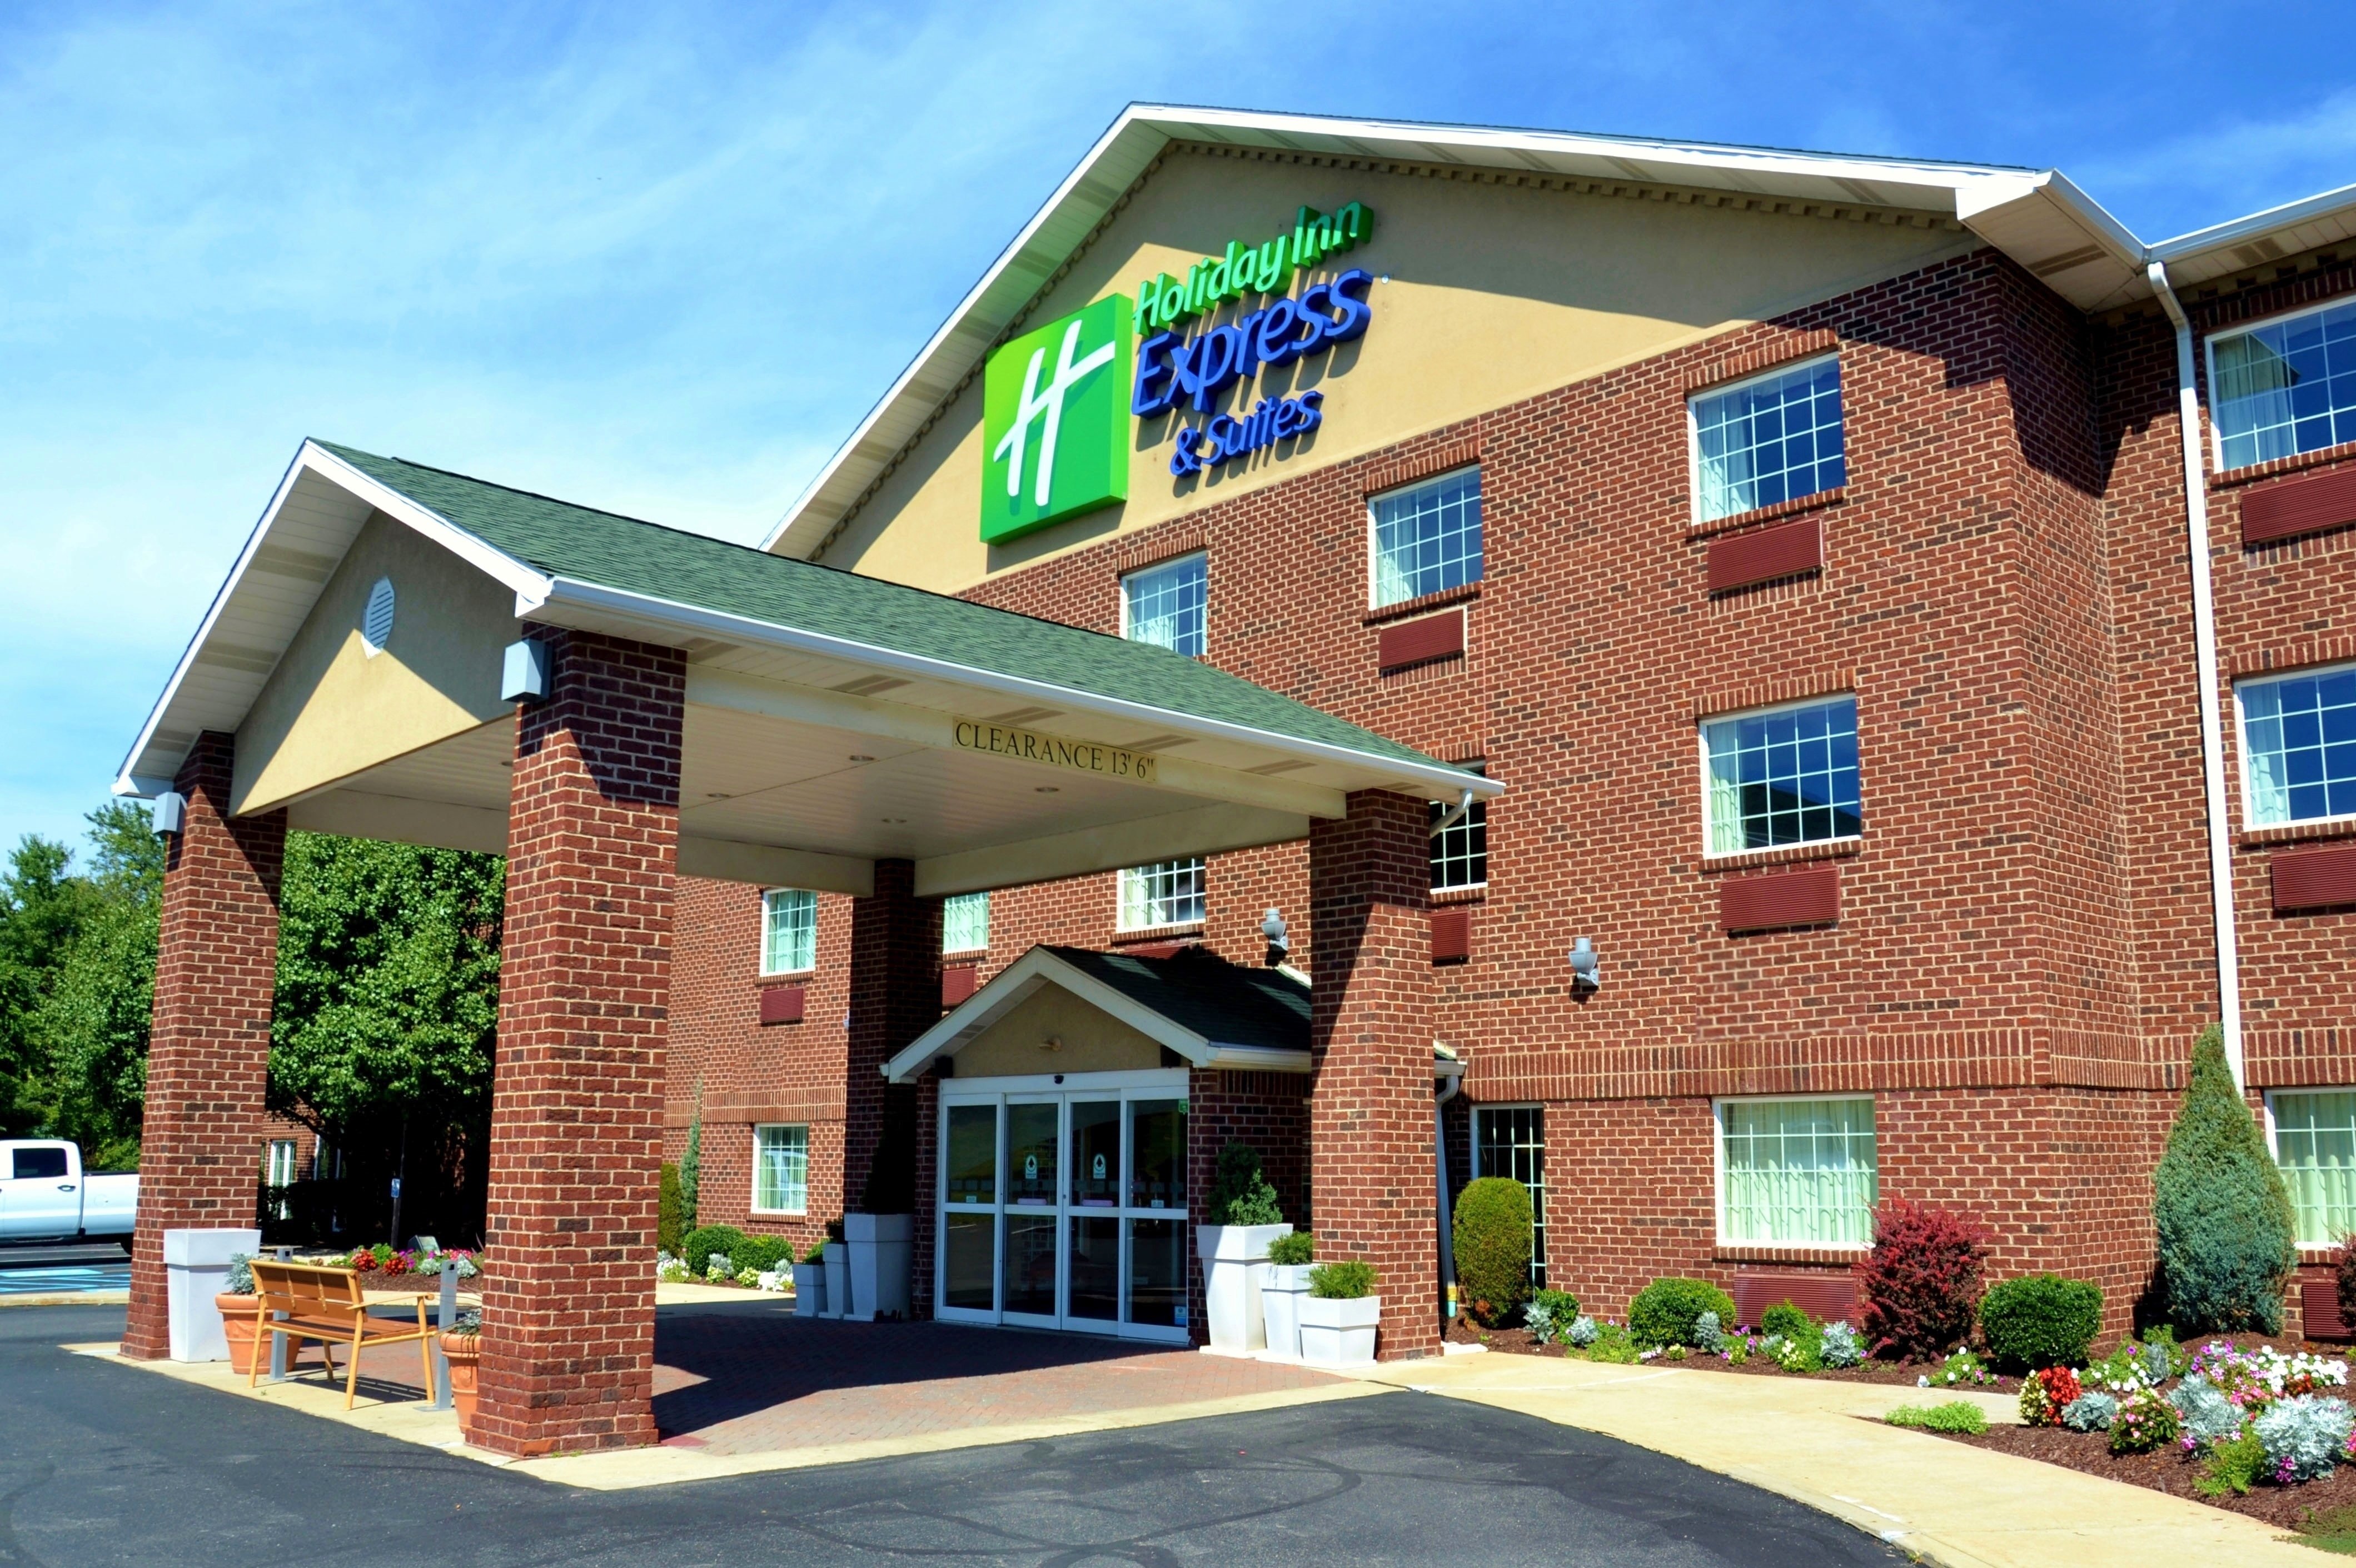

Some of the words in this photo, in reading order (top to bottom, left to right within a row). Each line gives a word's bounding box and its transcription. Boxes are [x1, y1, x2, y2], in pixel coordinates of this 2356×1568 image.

[1133, 233, 1293, 336] Holiday
[1292, 201, 1373, 267] Inn
[1132, 268, 1372, 418] Express
[993, 319, 1115, 506] H
[1170, 427, 1201, 477] &
[1202, 391, 1324, 467] Suites
[955, 722, 1103, 771] CLEARANCE
[1112, 751, 1131, 775] 13'
